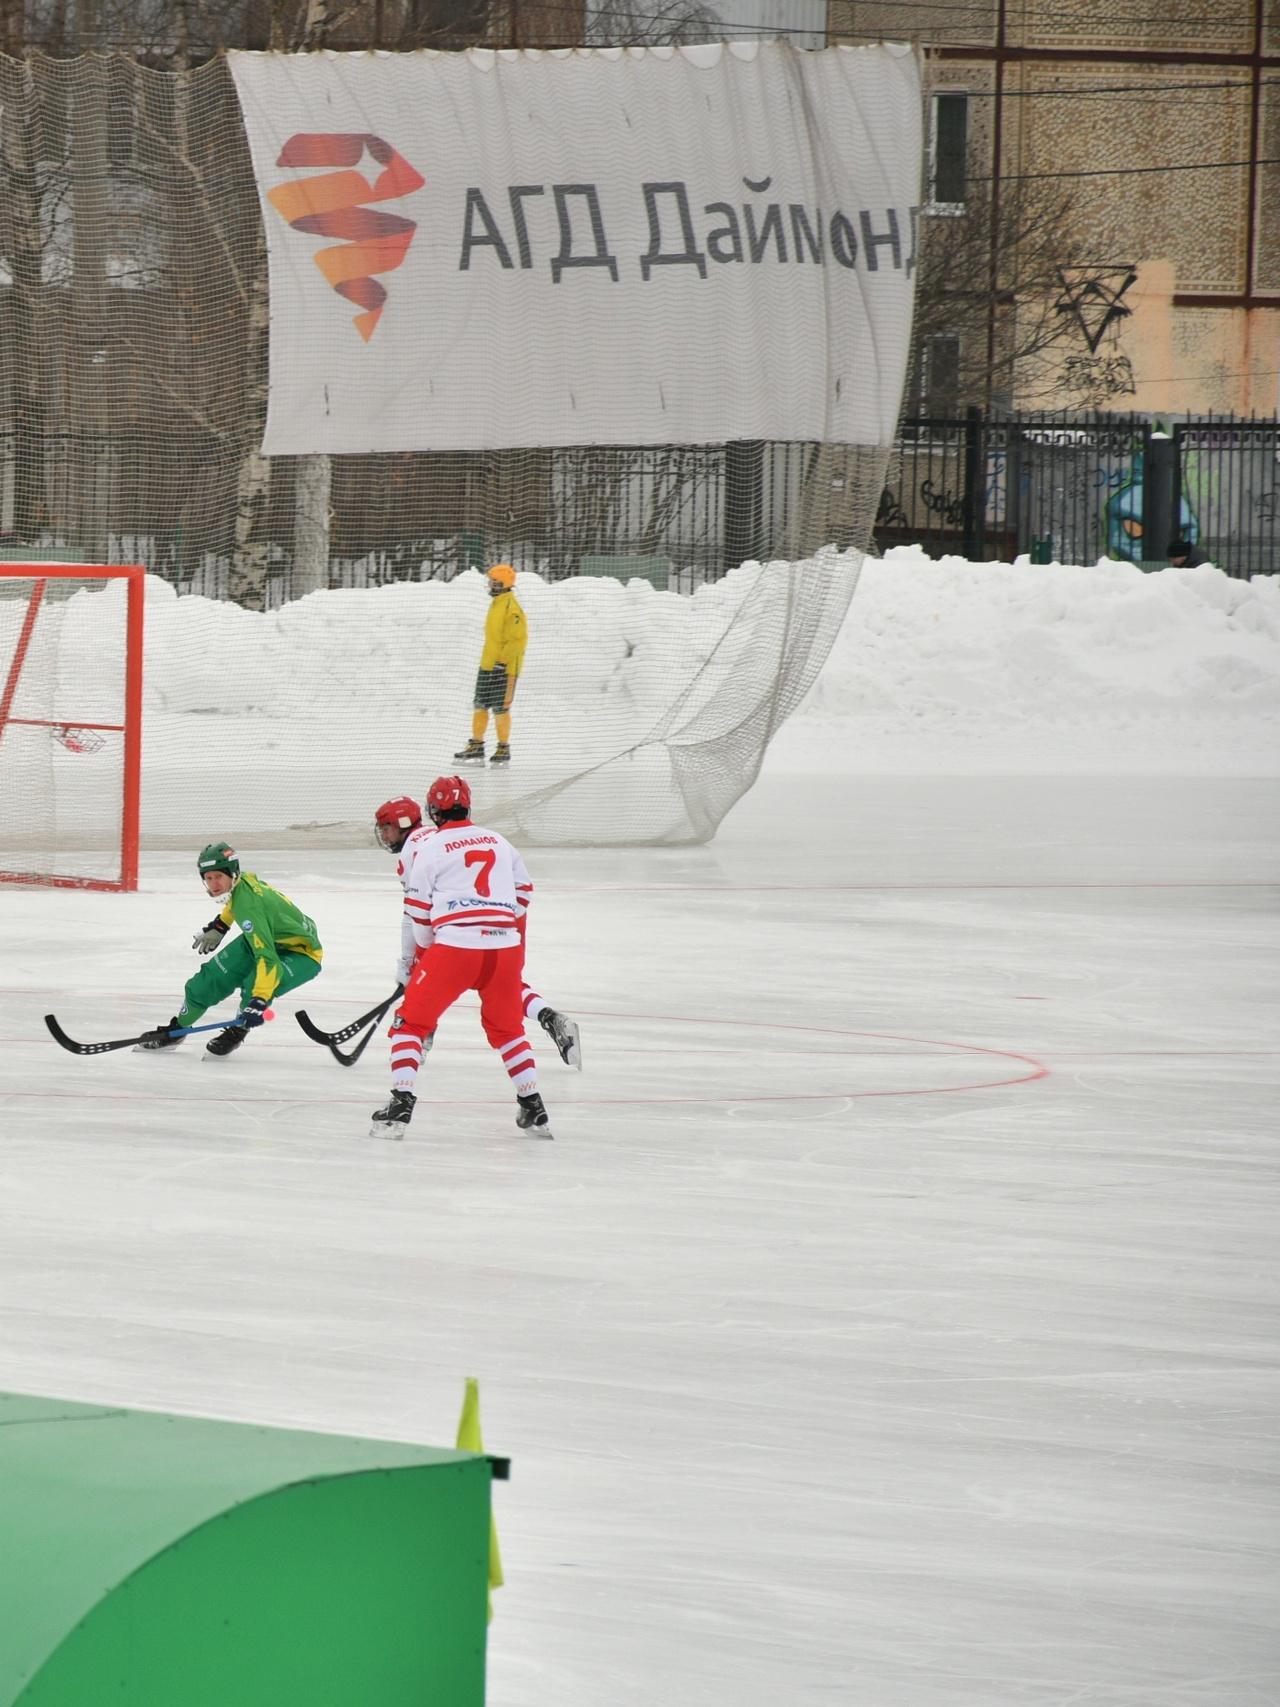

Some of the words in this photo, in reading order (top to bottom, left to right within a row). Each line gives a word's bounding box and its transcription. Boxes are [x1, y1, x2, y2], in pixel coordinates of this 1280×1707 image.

[459, 184, 619, 284] АГД
[452, 790, 460, 801] 7
[443, 836, 498, 853] ЛОМАНОВ
[464, 848, 496, 898] 7
[417, 970, 427, 985] 7
